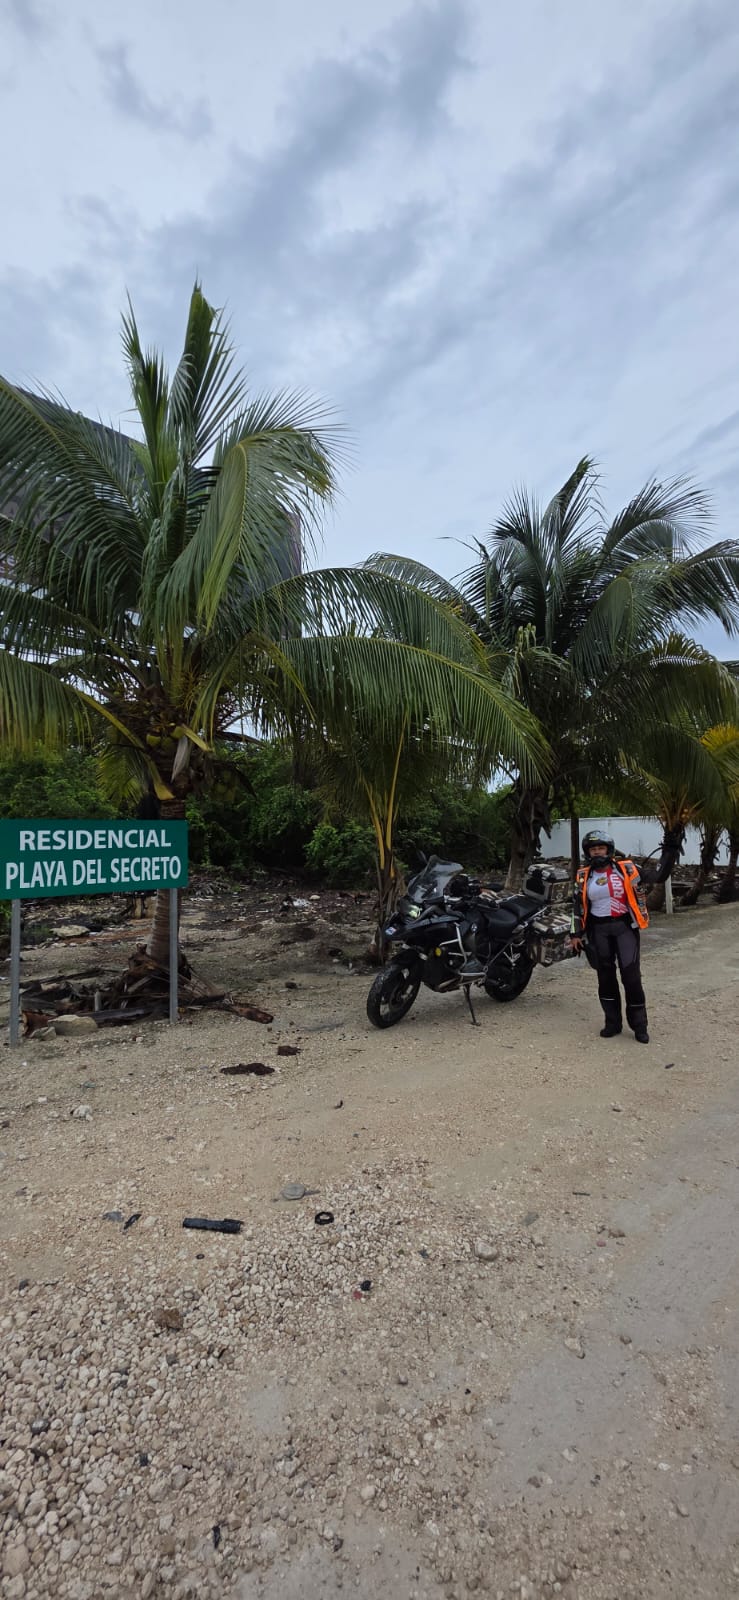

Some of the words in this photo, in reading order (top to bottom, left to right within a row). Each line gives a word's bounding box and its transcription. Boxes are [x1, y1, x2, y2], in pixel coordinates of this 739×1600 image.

[19, 829, 172, 851] RESIDENCIAL
[5, 860, 68, 890] PLAYA
[72, 859, 107, 886] DEL
[110, 855, 182, 883] SECRETO
